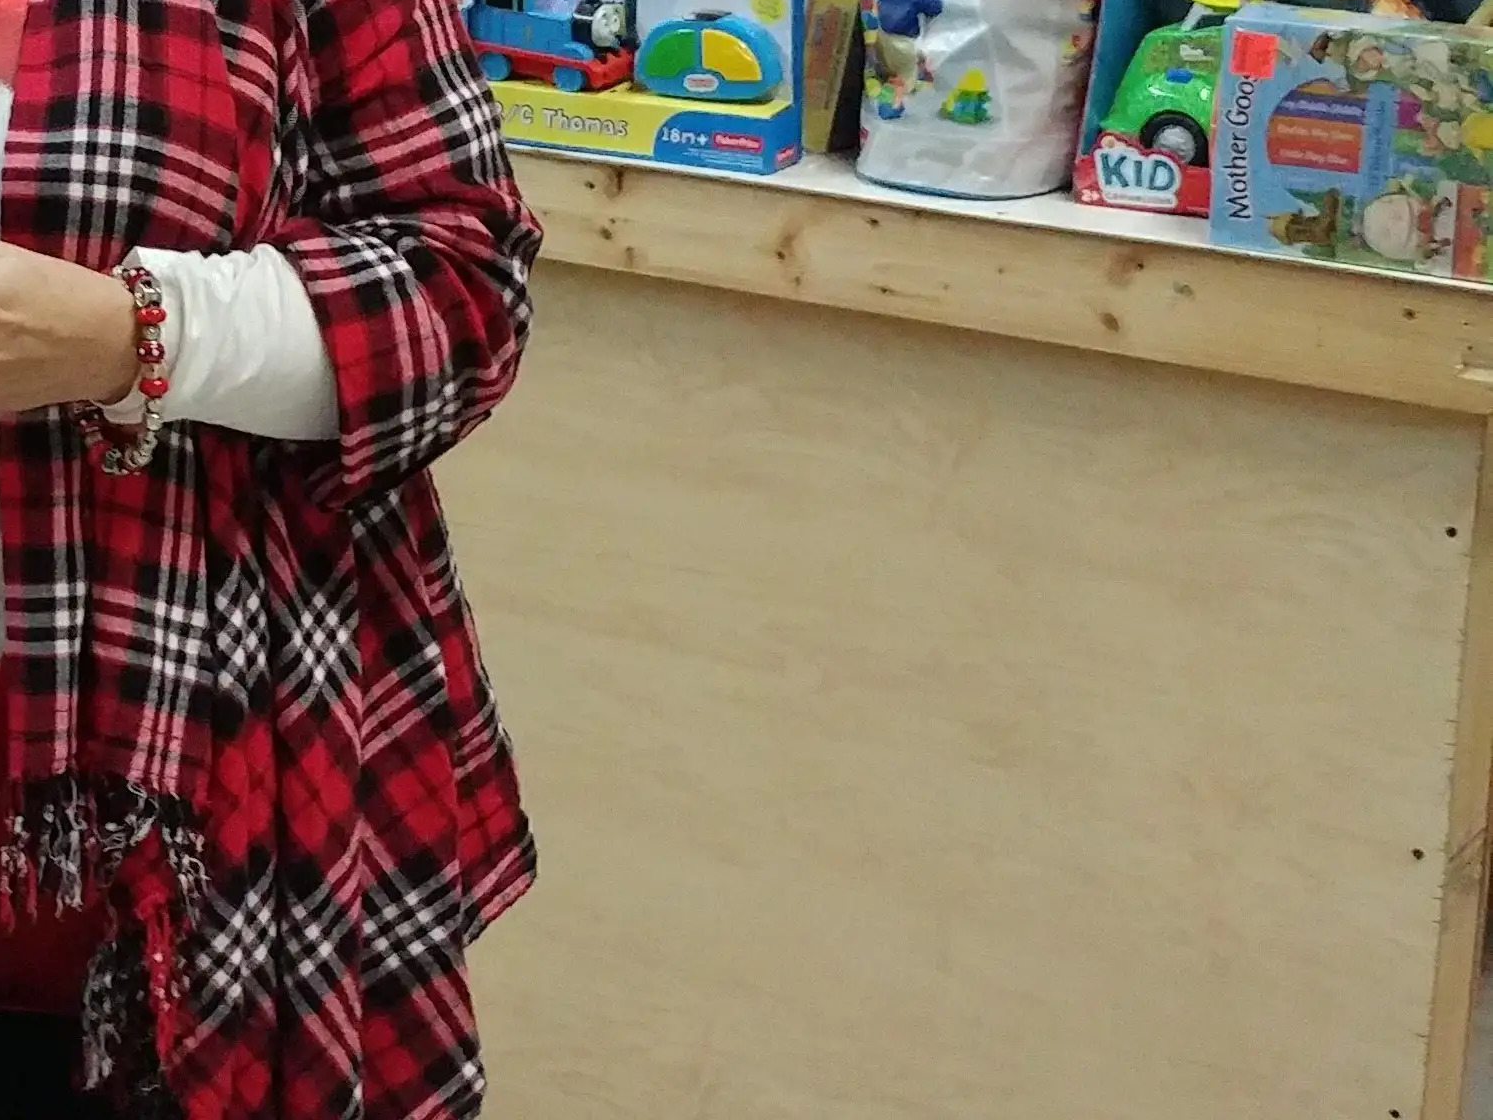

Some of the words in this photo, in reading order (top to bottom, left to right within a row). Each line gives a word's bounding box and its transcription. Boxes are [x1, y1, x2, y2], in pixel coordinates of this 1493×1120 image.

[543, 108, 629, 138] Thomas
[1100, 152, 1175, 191] KID
[1223, 133, 1252, 220] Mother
